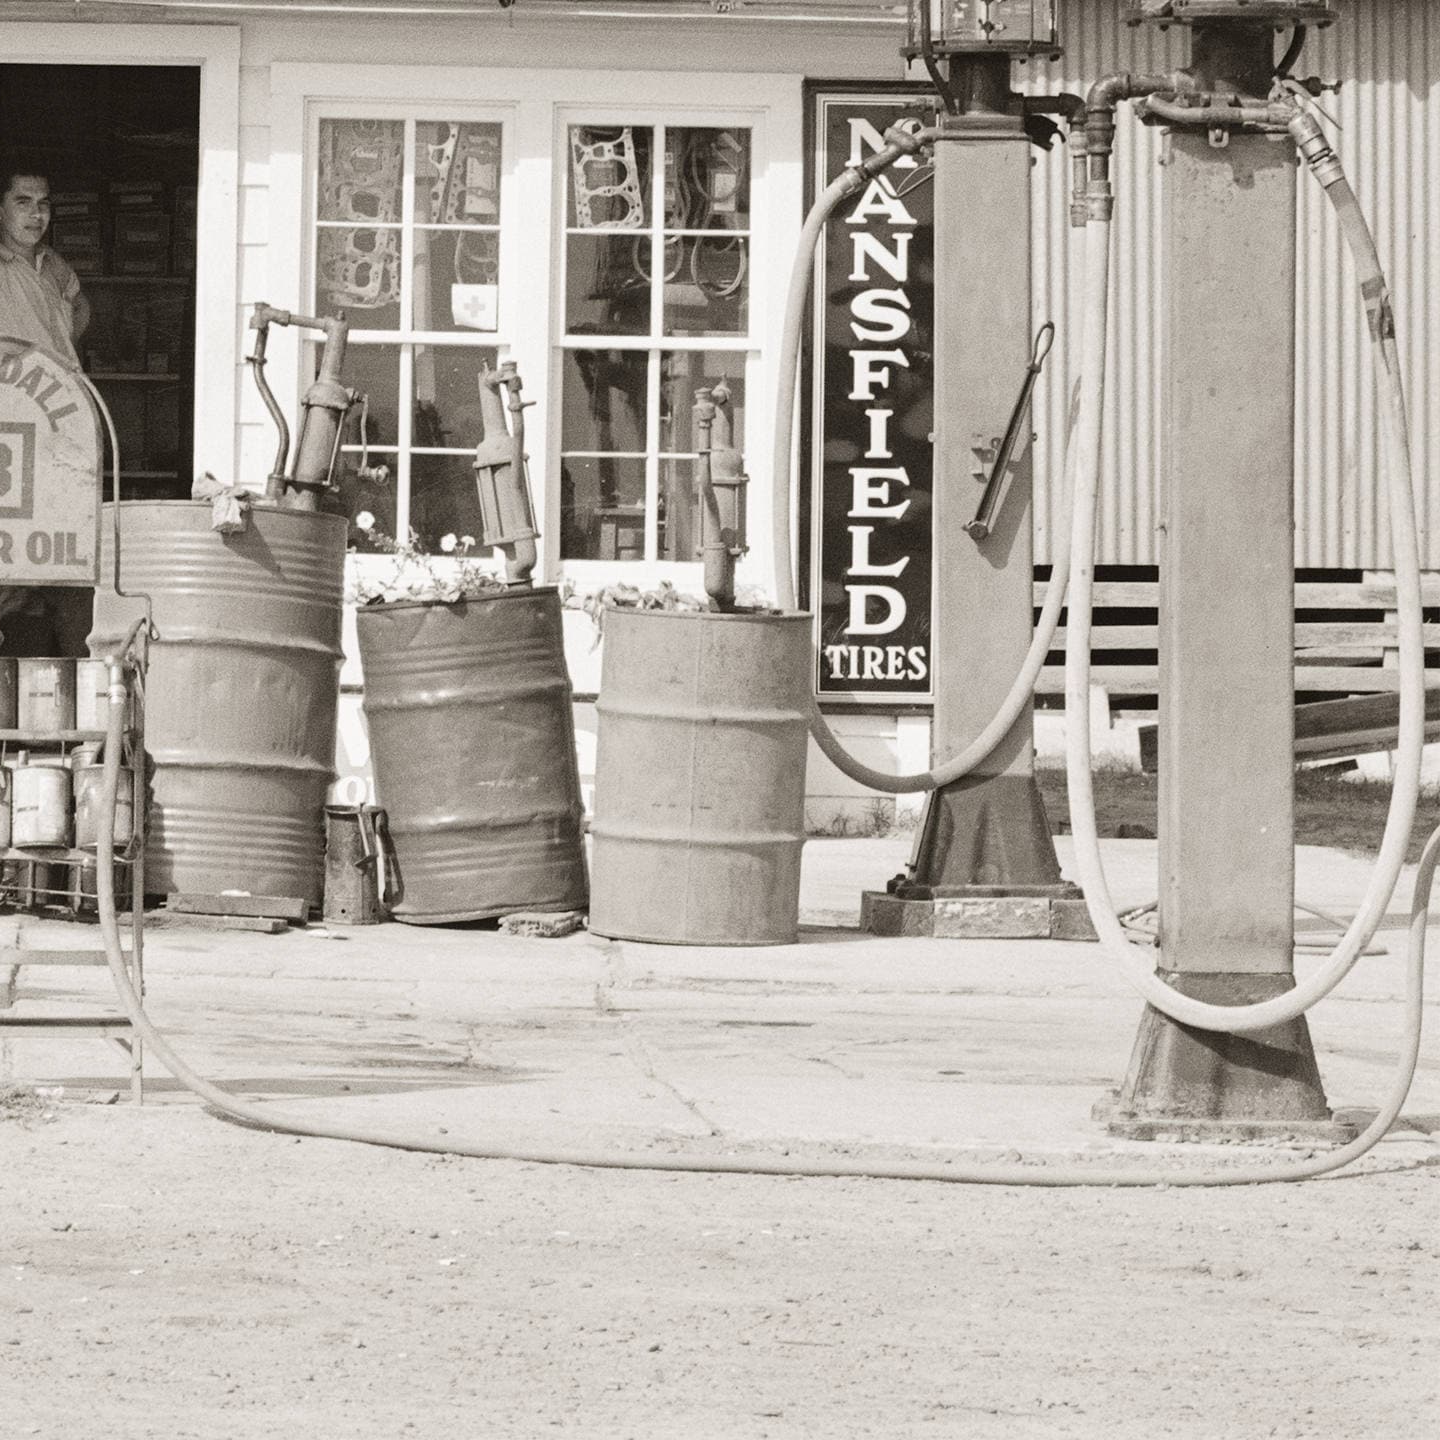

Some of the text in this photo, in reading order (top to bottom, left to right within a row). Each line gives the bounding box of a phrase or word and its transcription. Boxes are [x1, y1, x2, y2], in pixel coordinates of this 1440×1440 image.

[843, 117, 919, 636] MANSFIELD
[26, 530, 89, 568] OIL
[825, 644, 928, 681] TIRES
